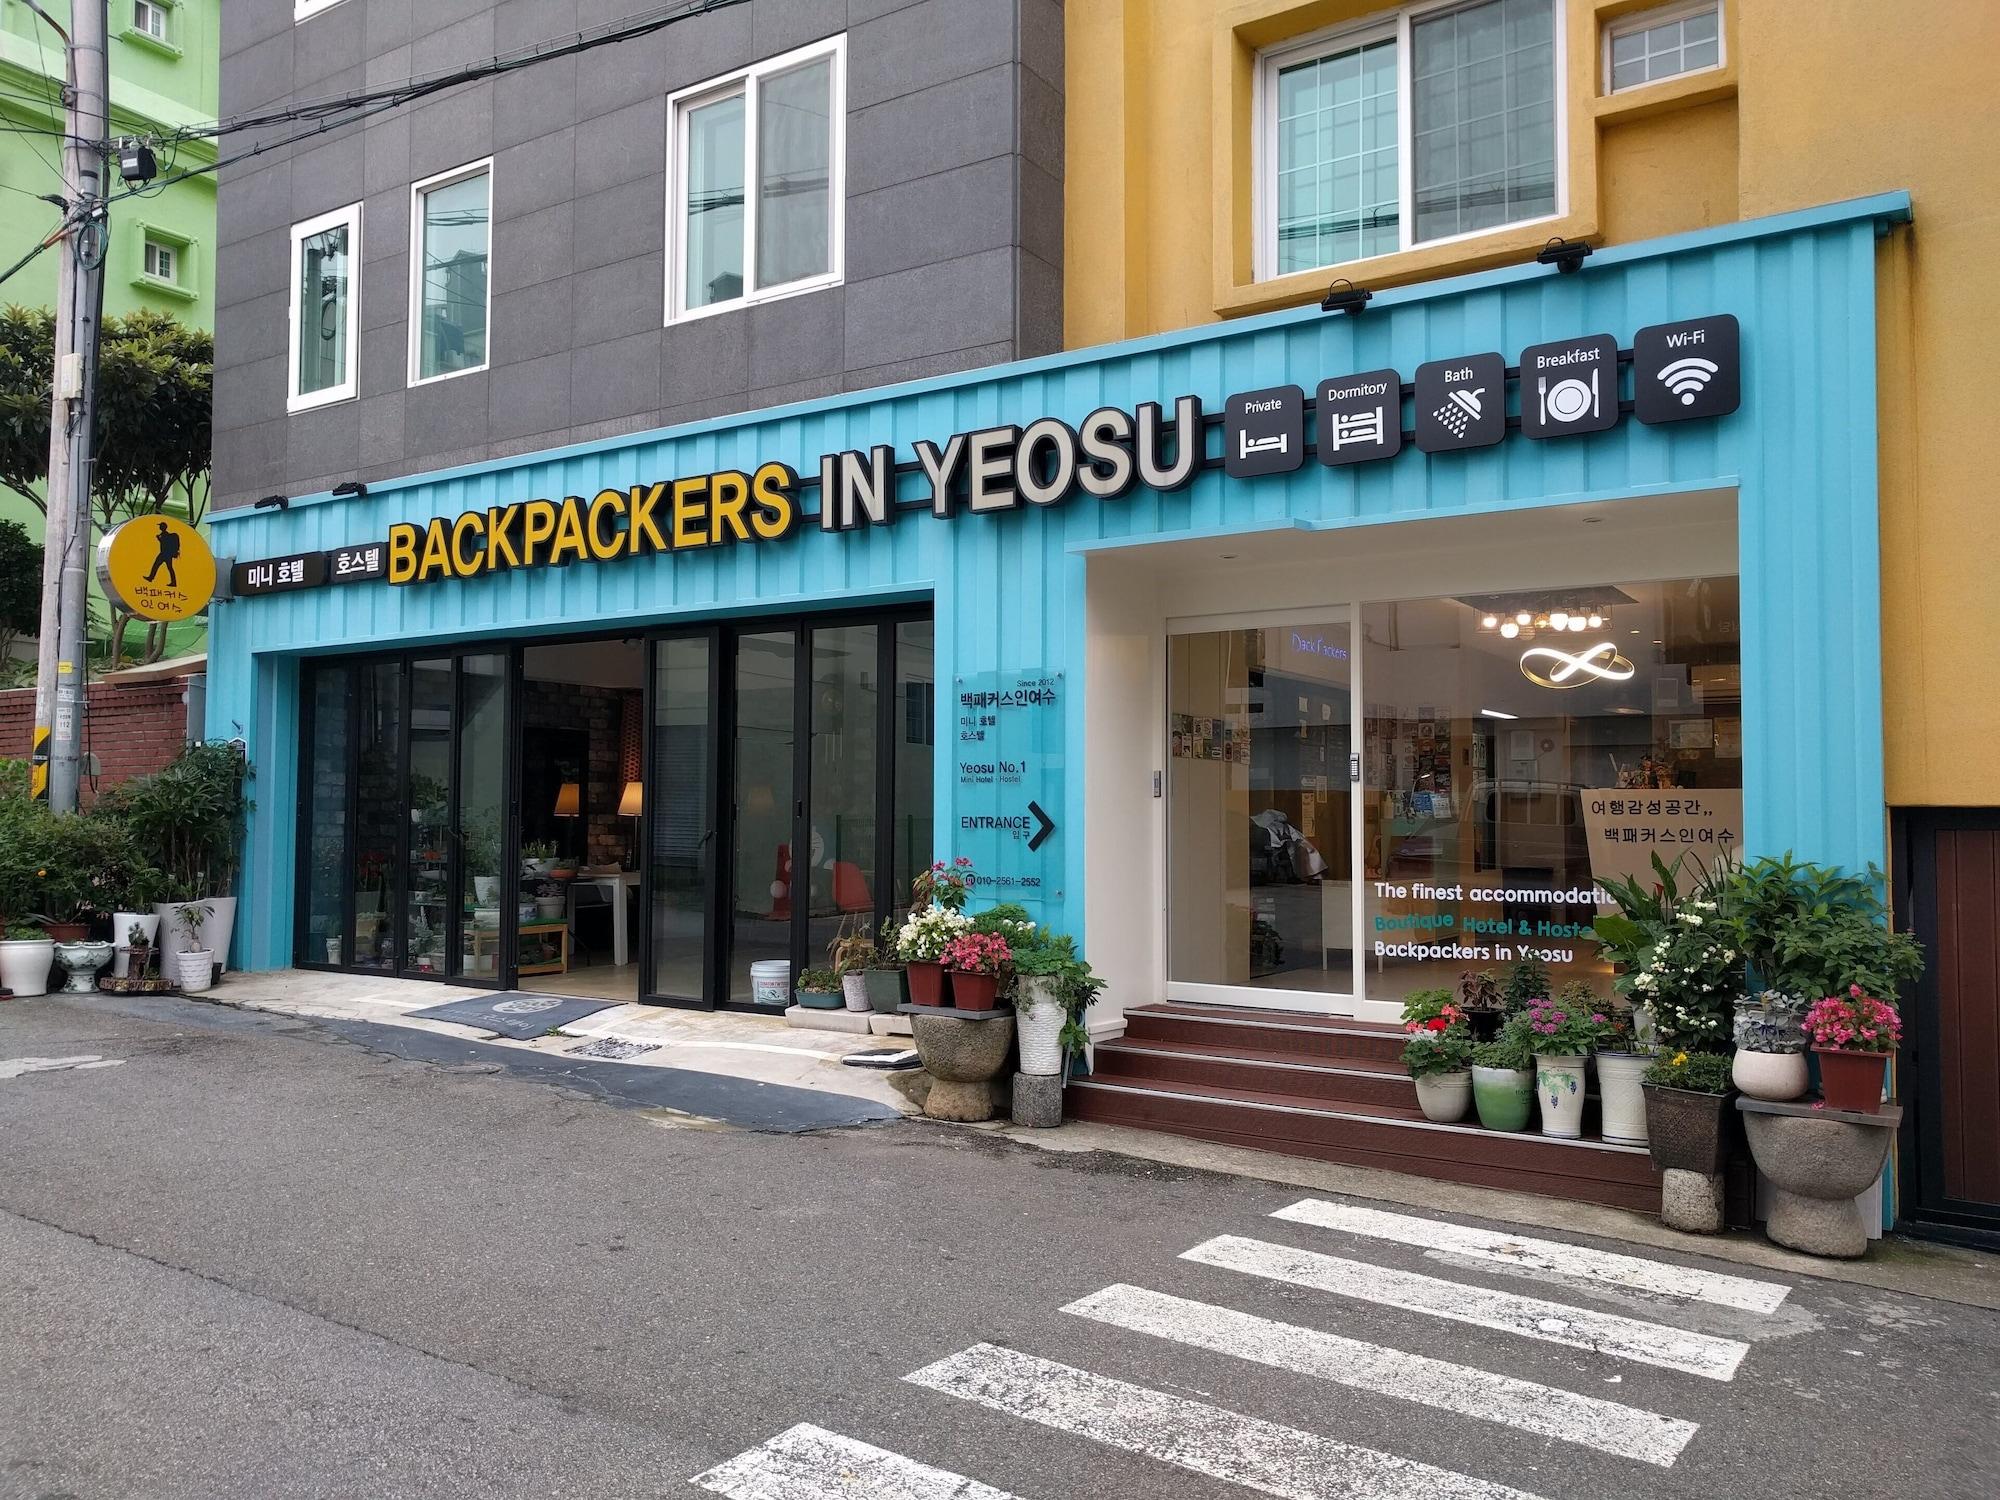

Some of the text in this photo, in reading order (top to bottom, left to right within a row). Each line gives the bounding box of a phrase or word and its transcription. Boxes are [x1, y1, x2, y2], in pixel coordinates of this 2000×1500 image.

[1666, 329, 1705, 348] Wi-Fi
[1537, 347, 1600, 369] Breakfast
[1444, 366, 1474, 383] Bath
[1328, 382, 1388, 401] Dormitory
[1245, 398, 1282, 414] Private
[389, 395, 1199, 585] BACKPACKERS IN YEOSU
[336, 547, 380, 575] 호스텔
[248, 559, 304, 587] 미니 호텔
[135, 586, 188, 601] 백패커스
[1017, 678, 1055, 687] Since 2012
[960, 688, 1056, 708] 백패커스인여수
[960, 715, 996, 727] 미니 호텔
[960, 730, 985, 741] 호스텔
[960, 760, 1026, 774] Yeosu No.1
[1000, 775, 1021, 783] Hostel
[961, 816, 1031, 829] ENTRANCE
[1604, 827, 1735, 843] 백패커스인여수
[977, 876, 1041, 887] 010-2561-2552
[1374, 882, 1407, 899] The
[1411, 883, 1463, 901] finest
[1374, 913, 1454, 931] Boutique
[1463, 917, 1512, 935] Hotel
[1518, 919, 1532, 937] &
[1374, 941, 1490, 961] Backpackers
[1495, 944, 1512, 961] in
